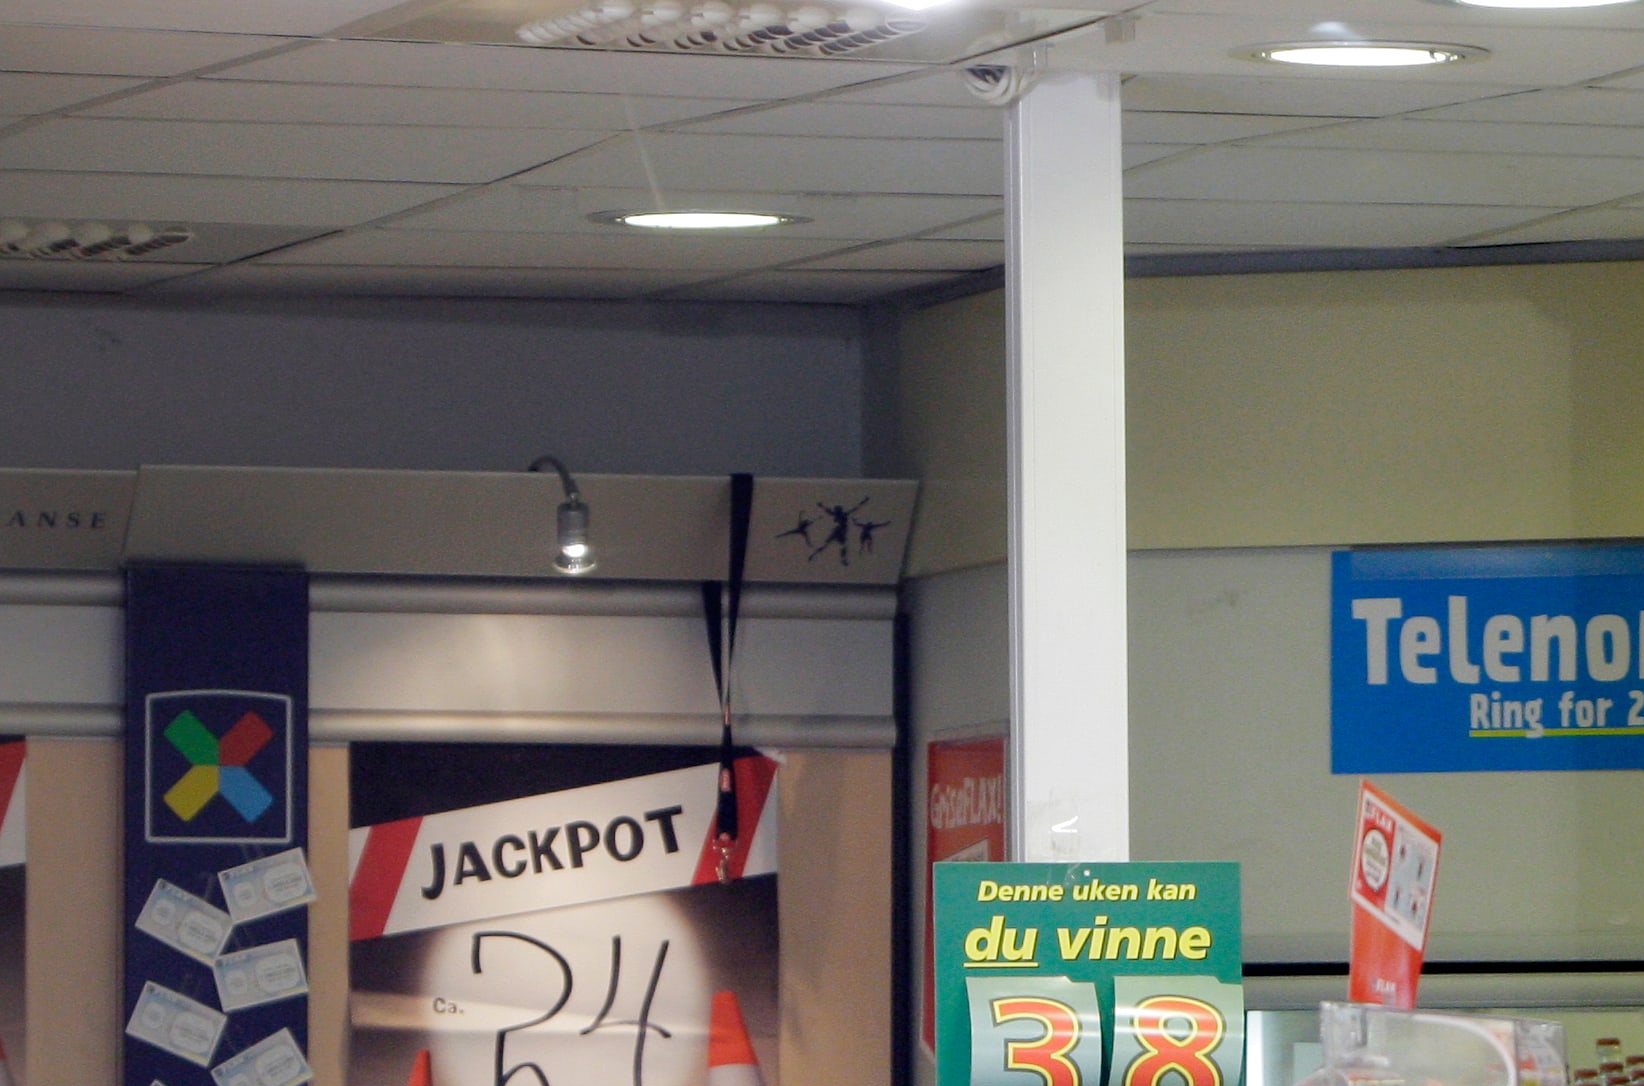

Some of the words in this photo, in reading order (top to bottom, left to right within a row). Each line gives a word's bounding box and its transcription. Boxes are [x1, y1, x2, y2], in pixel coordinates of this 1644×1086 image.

[1470, 691, 1544, 738] Ring
[1558, 691, 1613, 728] for
[421, 805, 683, 900] JACKPOT
[977, 881, 1064, 902] Denne
[1072, 879, 1139, 901] uken
[1147, 879, 1197, 901] kan
[964, 915, 1039, 964] du
[1057, 916, 1212, 961] vinne
[433, 998, 464, 1015] Ca.
